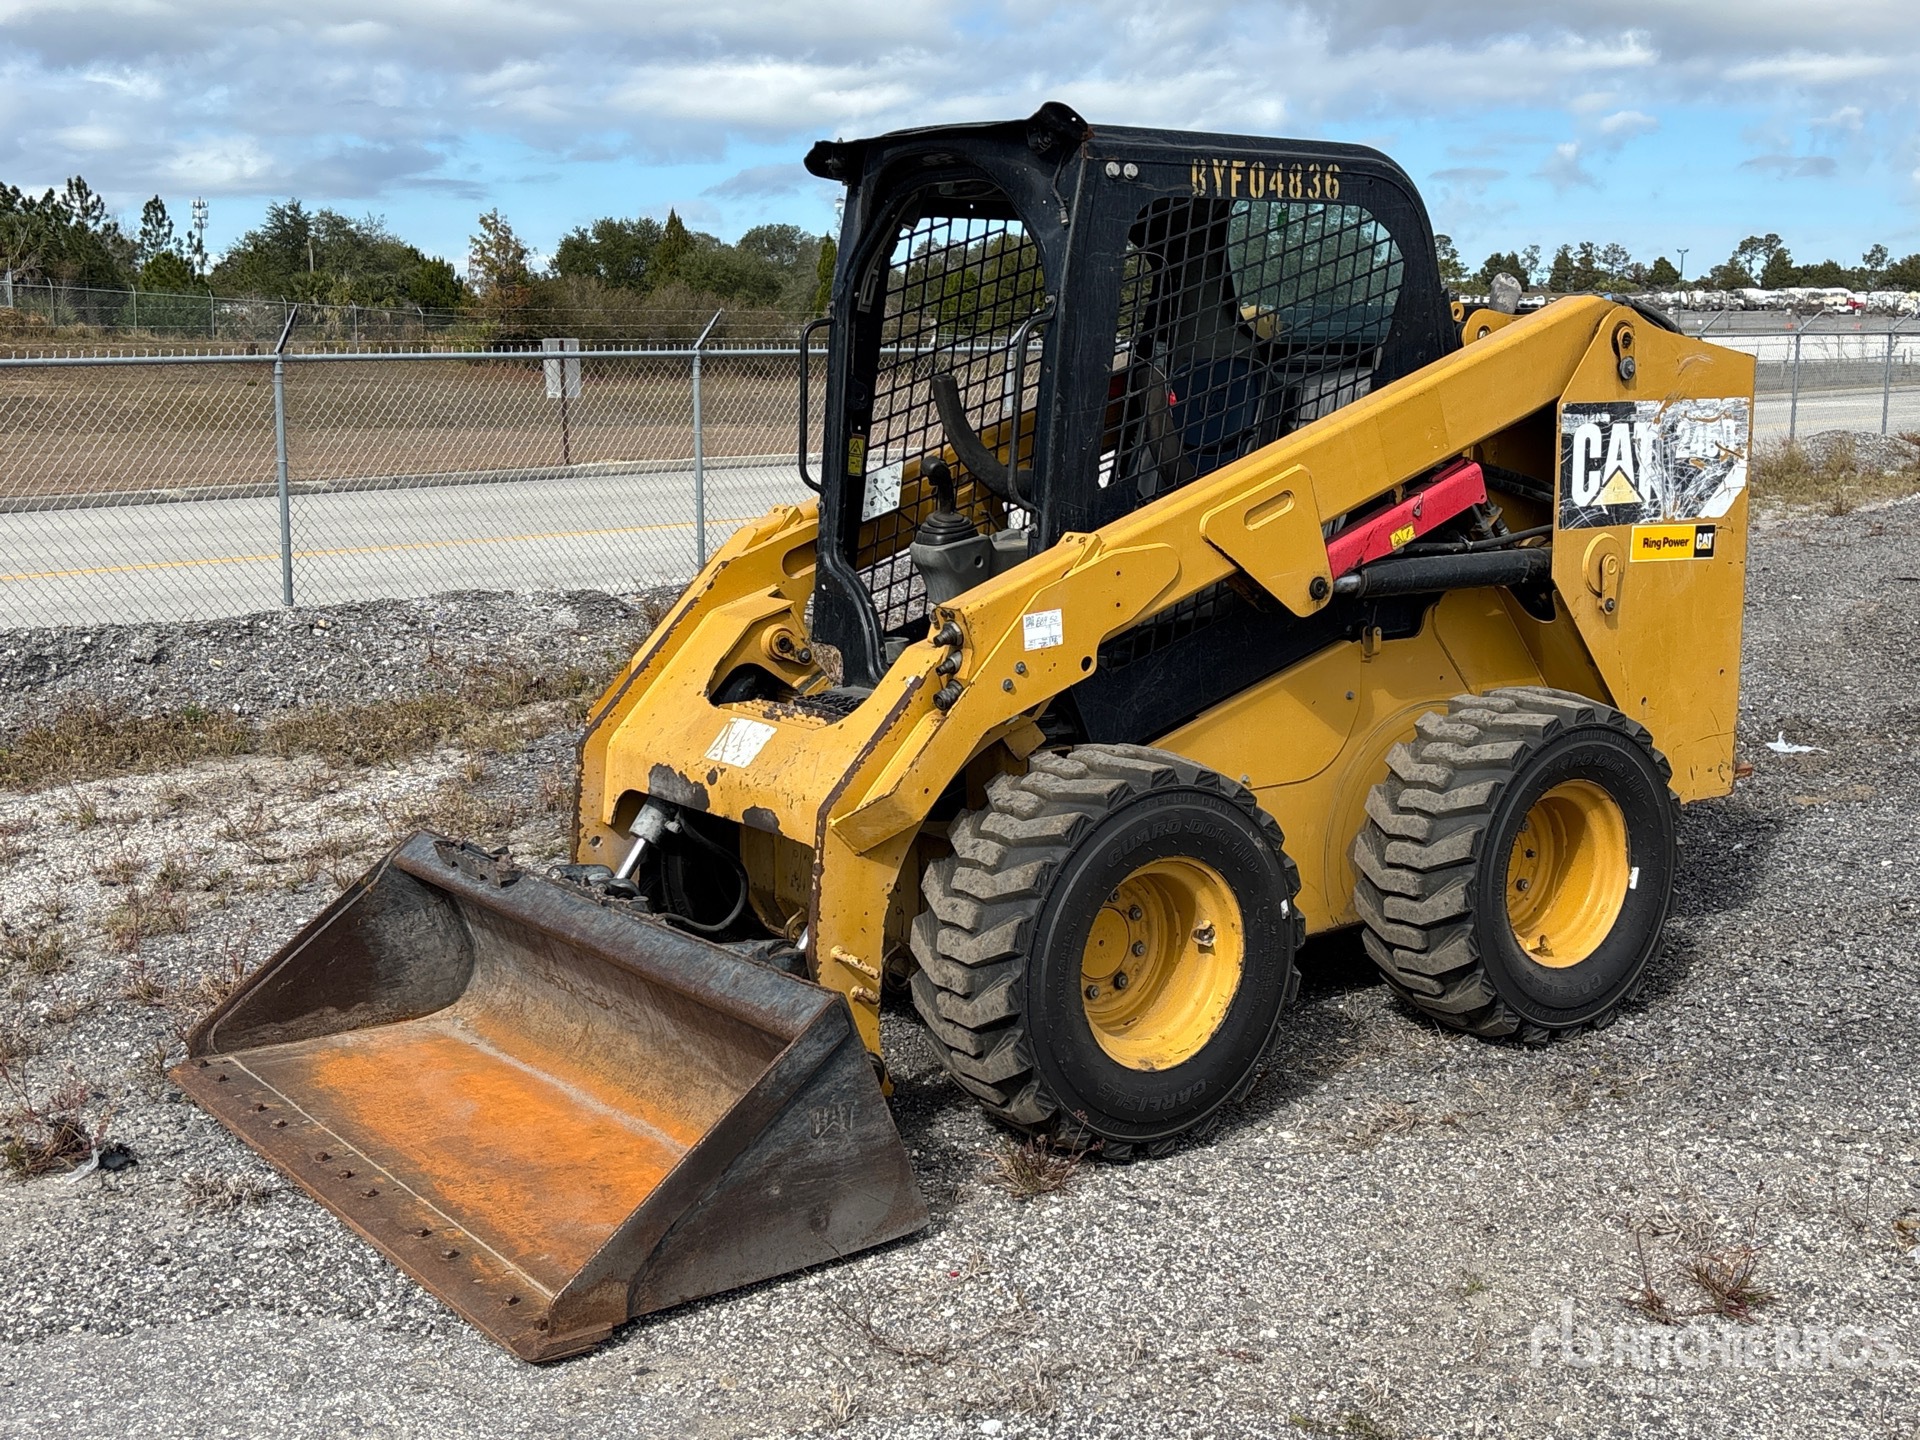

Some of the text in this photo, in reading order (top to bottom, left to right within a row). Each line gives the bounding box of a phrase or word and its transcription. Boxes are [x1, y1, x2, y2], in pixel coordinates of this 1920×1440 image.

[1191, 158, 1341, 199] BYF04836
[1572, 422, 1661, 507] CAT
[1642, 537, 1690, 550] Ring Power
[1696, 533, 1714, 549] CAT
[1201, 796, 1232, 816] DUTY
[1107, 818, 1182, 868] GUARD
[1186, 818, 1232, 846] DOG
[1095, 1078, 1208, 1112] CARLISLE
